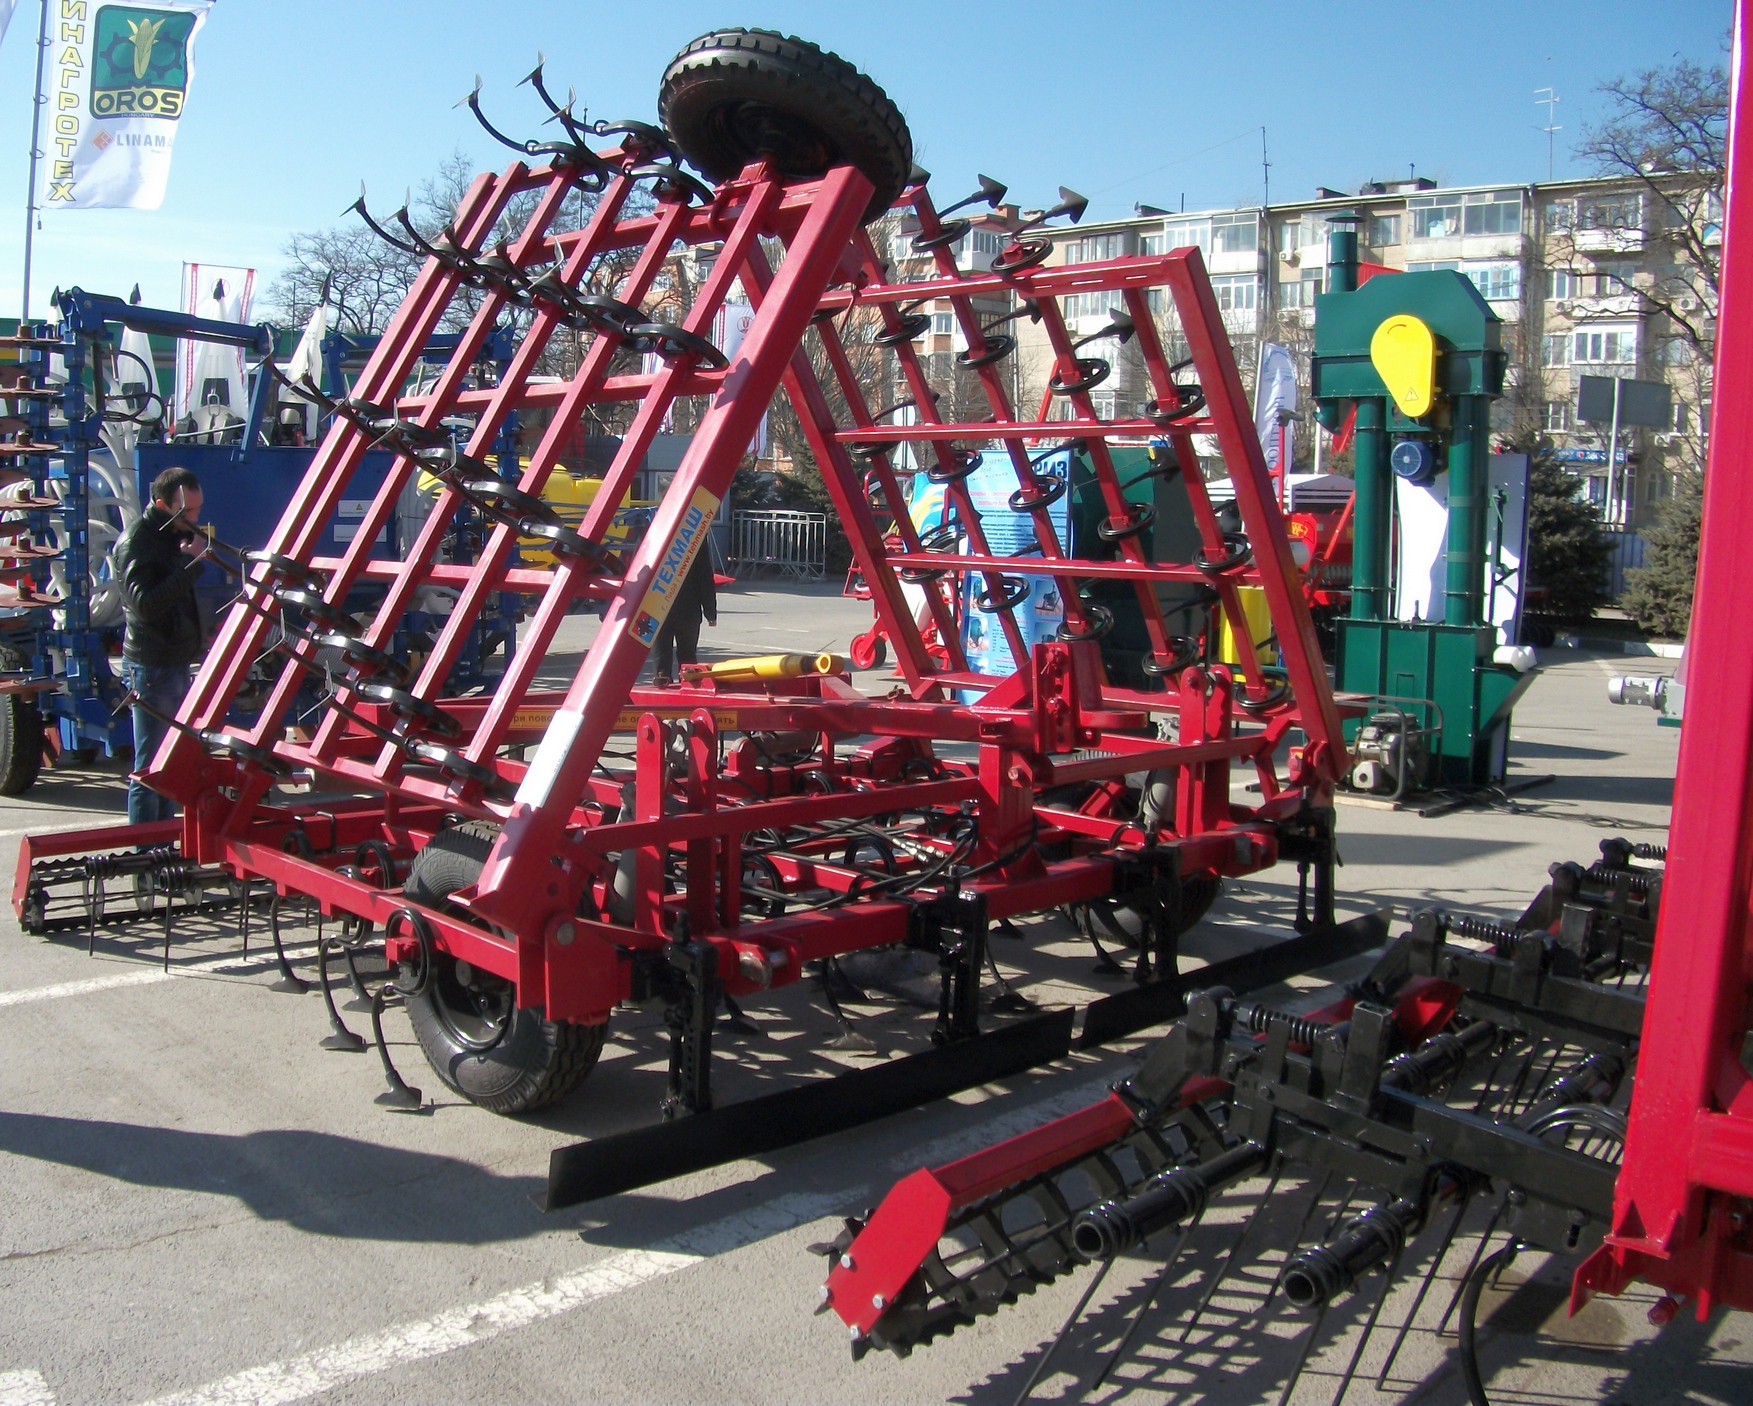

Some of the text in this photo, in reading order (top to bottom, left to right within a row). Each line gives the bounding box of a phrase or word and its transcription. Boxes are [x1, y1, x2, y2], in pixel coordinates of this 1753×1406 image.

[96, 90, 180, 114] OROS
[652, 505, 704, 595] ТЕХМАШ
[678, 508, 714, 577] www.tehmash.by
[513, 715, 526, 724] ри
